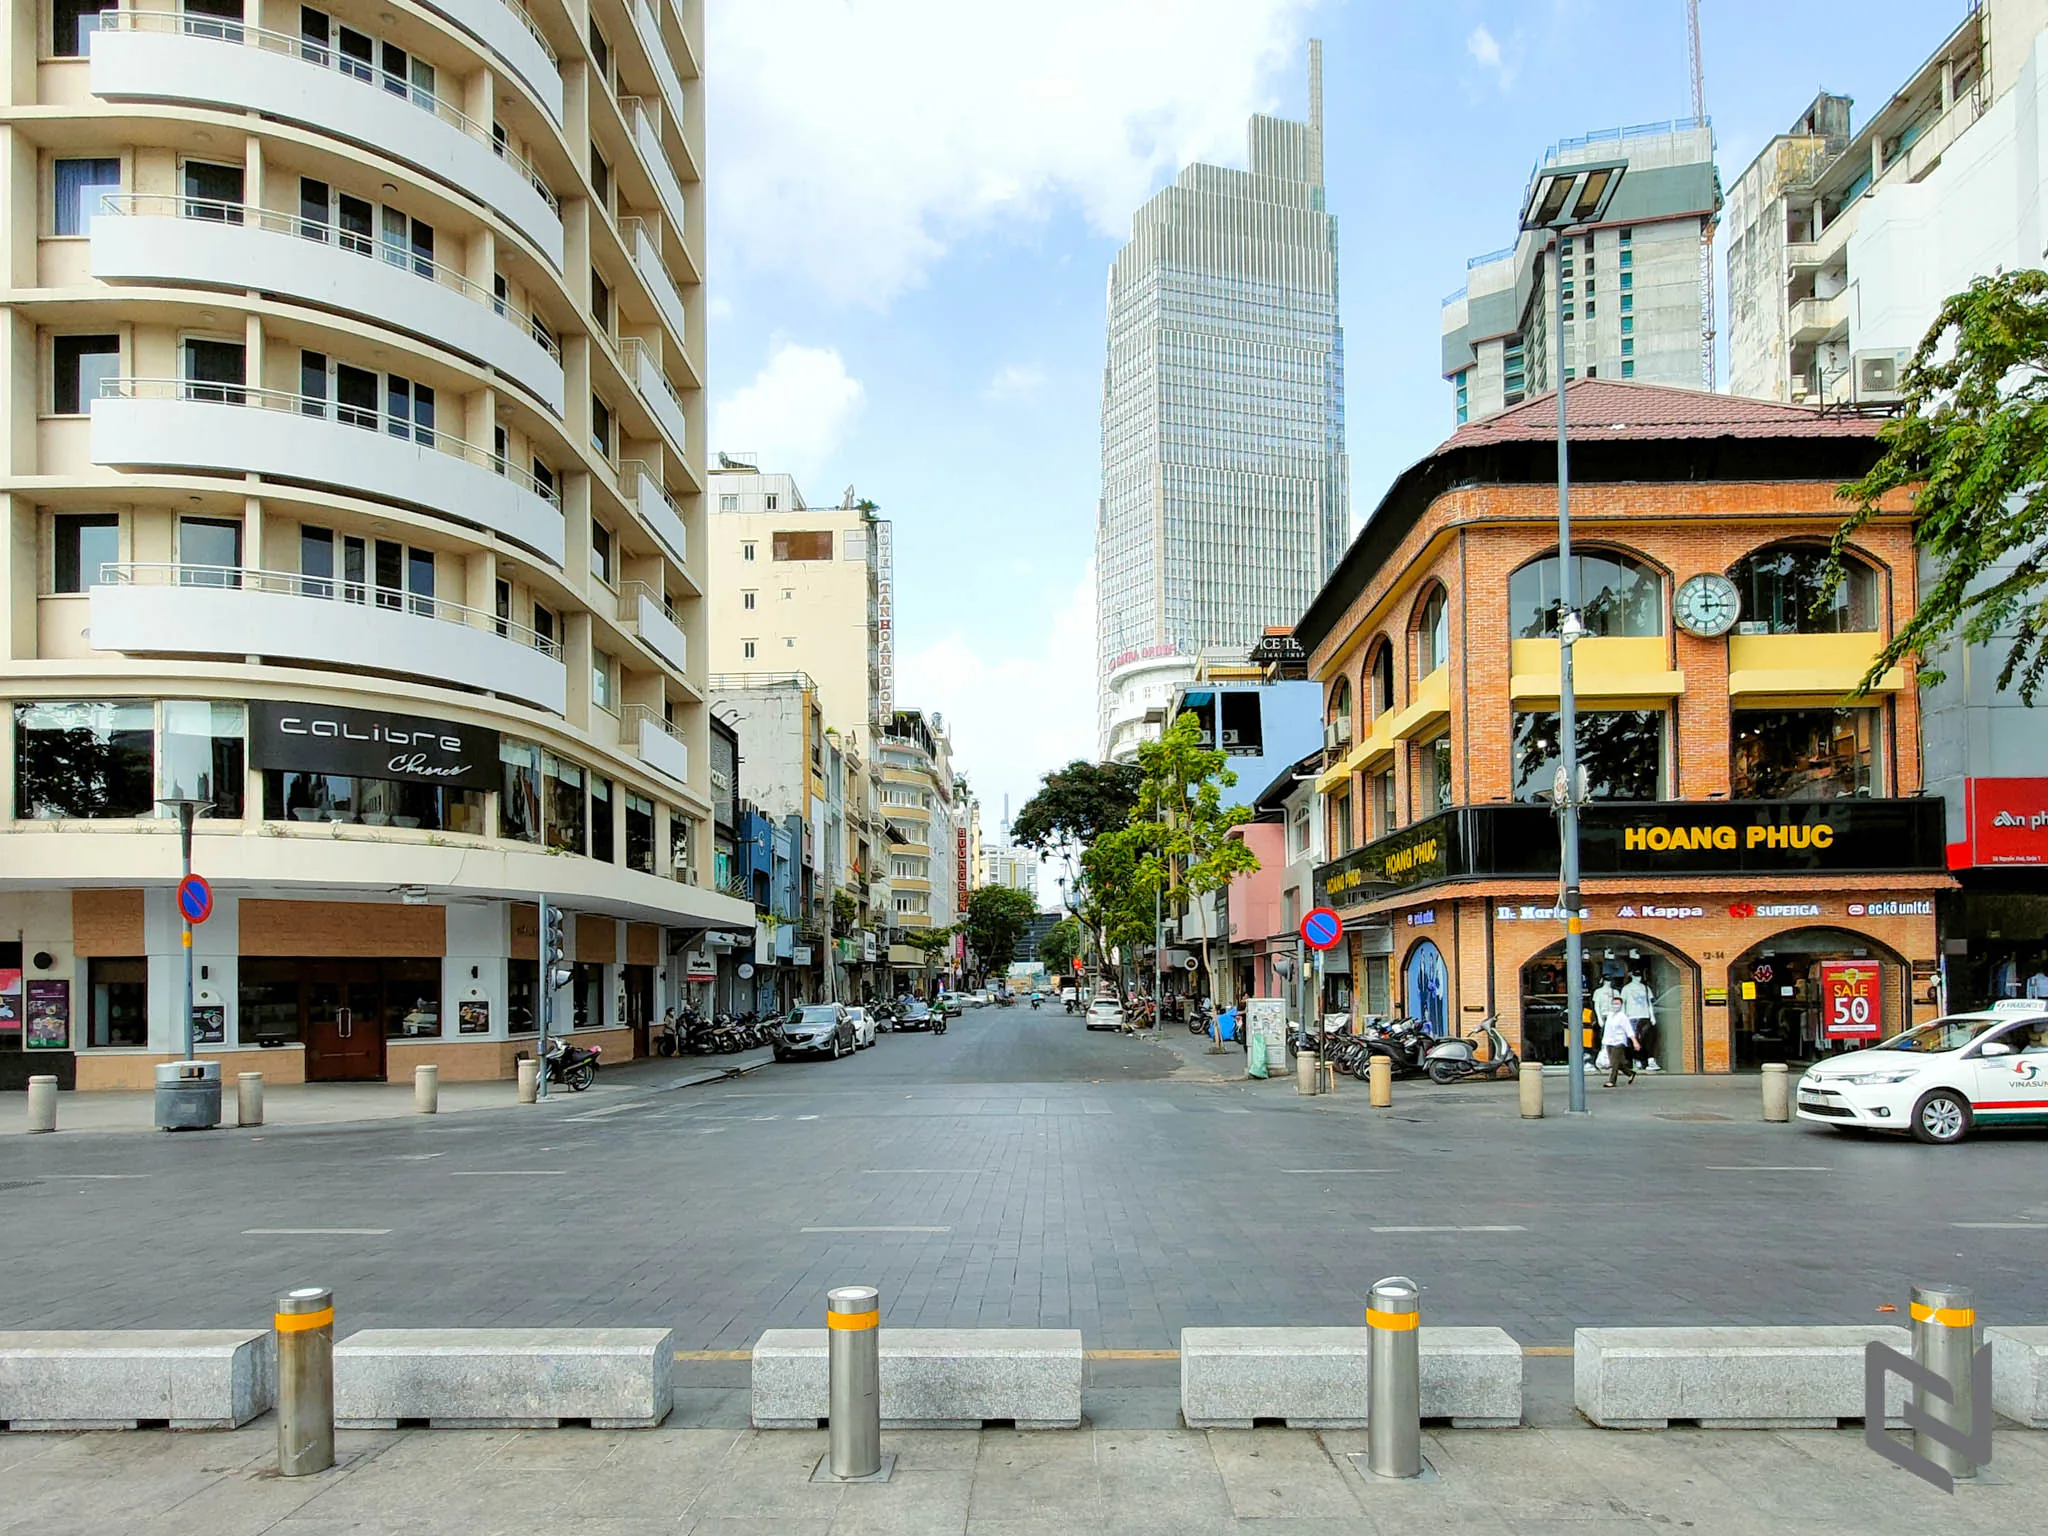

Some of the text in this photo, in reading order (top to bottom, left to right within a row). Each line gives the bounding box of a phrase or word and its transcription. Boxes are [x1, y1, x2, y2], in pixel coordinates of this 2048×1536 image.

[1624, 824, 1834, 850] HOANG PHUC
[1385, 838, 1437, 876] HOANG PHUC
[1520, 906, 1590, 920] Martes
[1642, 905, 1704, 918] Kappa
[1756, 904, 1820, 917] SUPERGA
[1833, 984, 1869, 997] SALE
